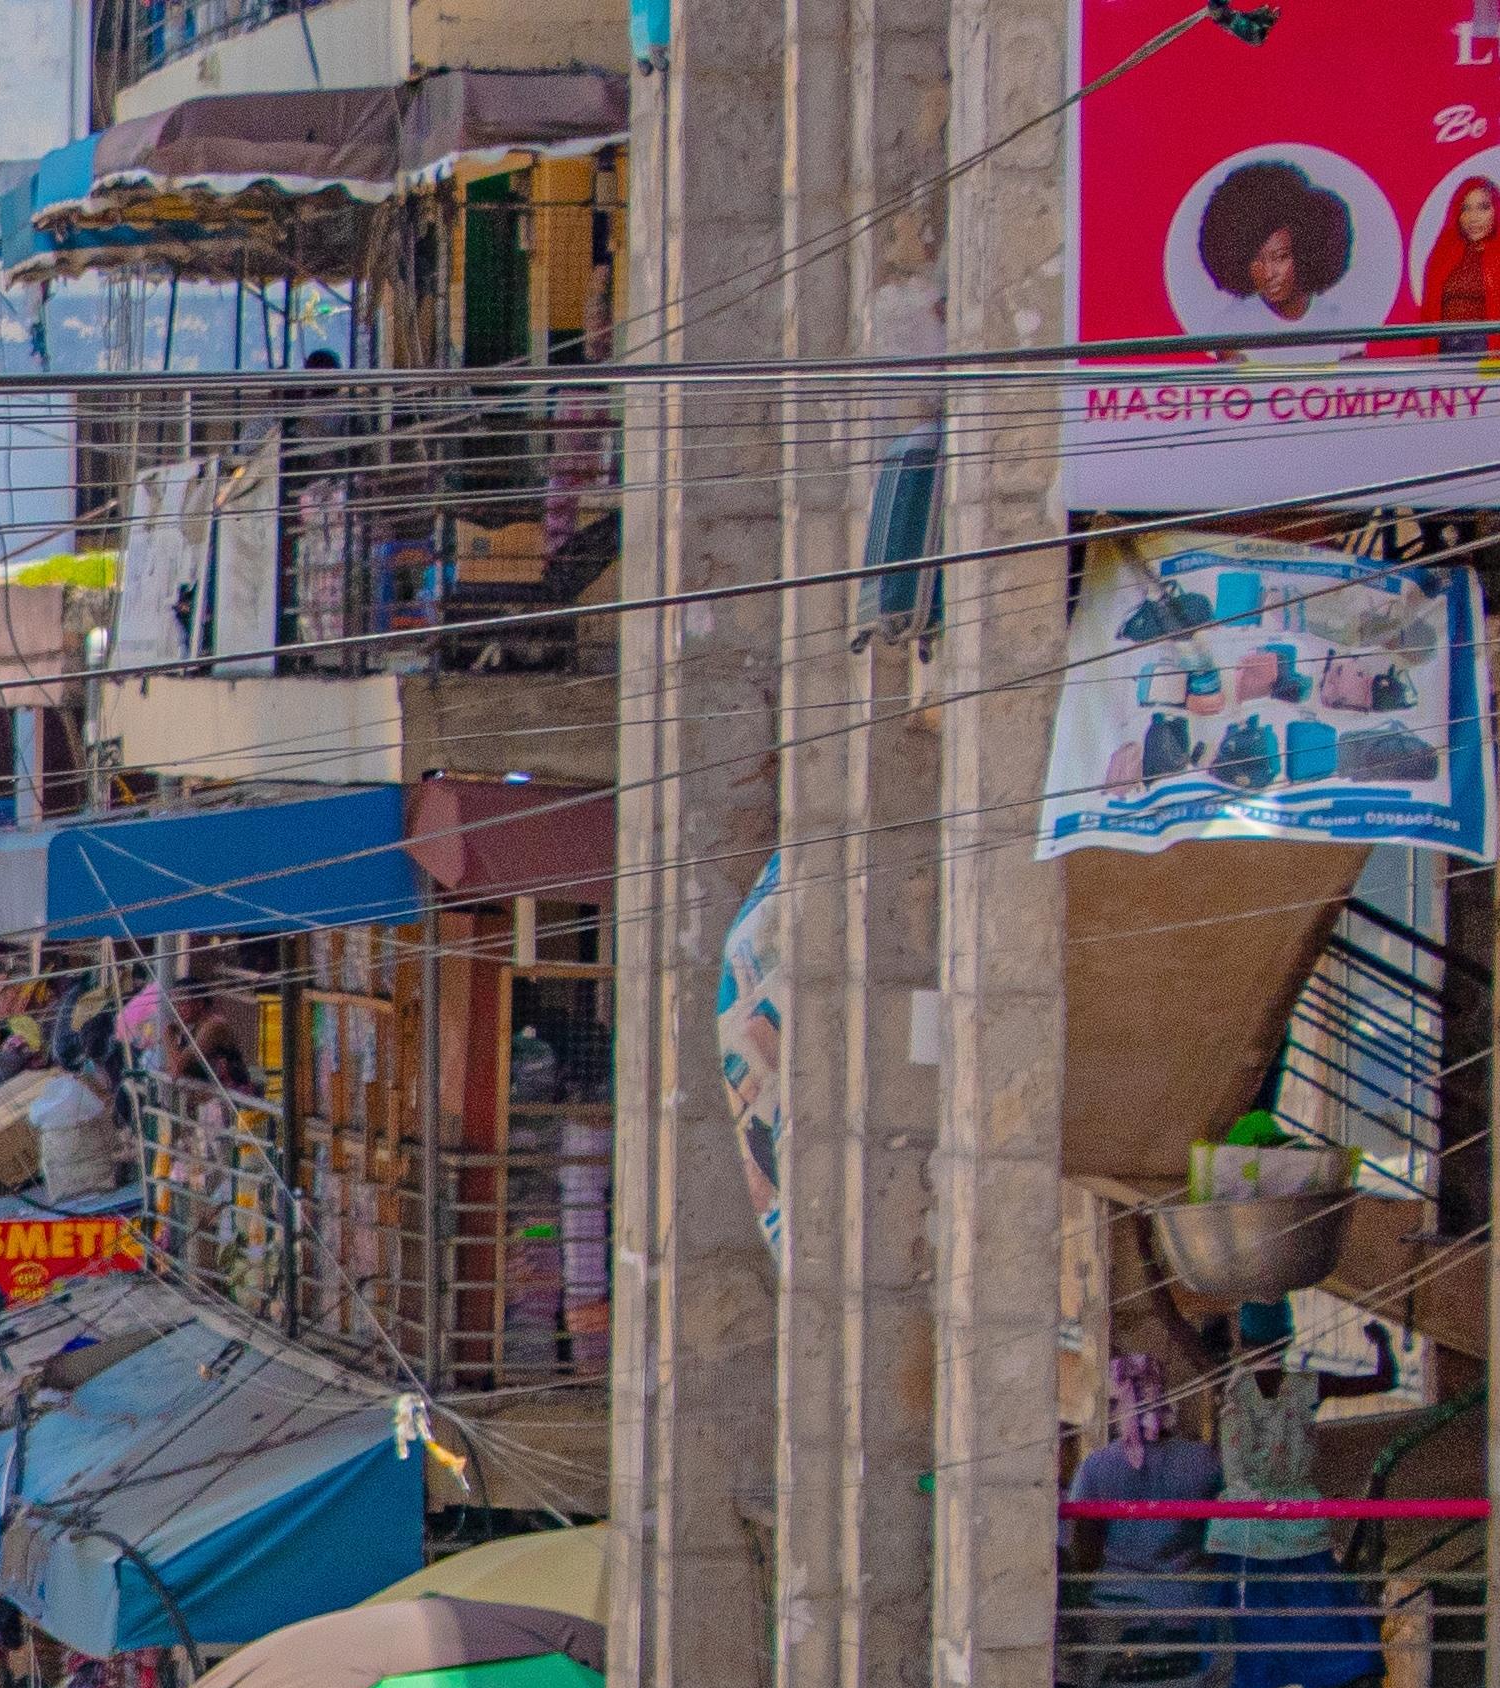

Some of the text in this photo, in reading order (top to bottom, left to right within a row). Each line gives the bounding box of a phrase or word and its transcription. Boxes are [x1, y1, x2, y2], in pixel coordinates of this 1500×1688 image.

[1433, 103, 1488, 143] Be
[1086, 384, 1489, 421] MASITO COMPANY
